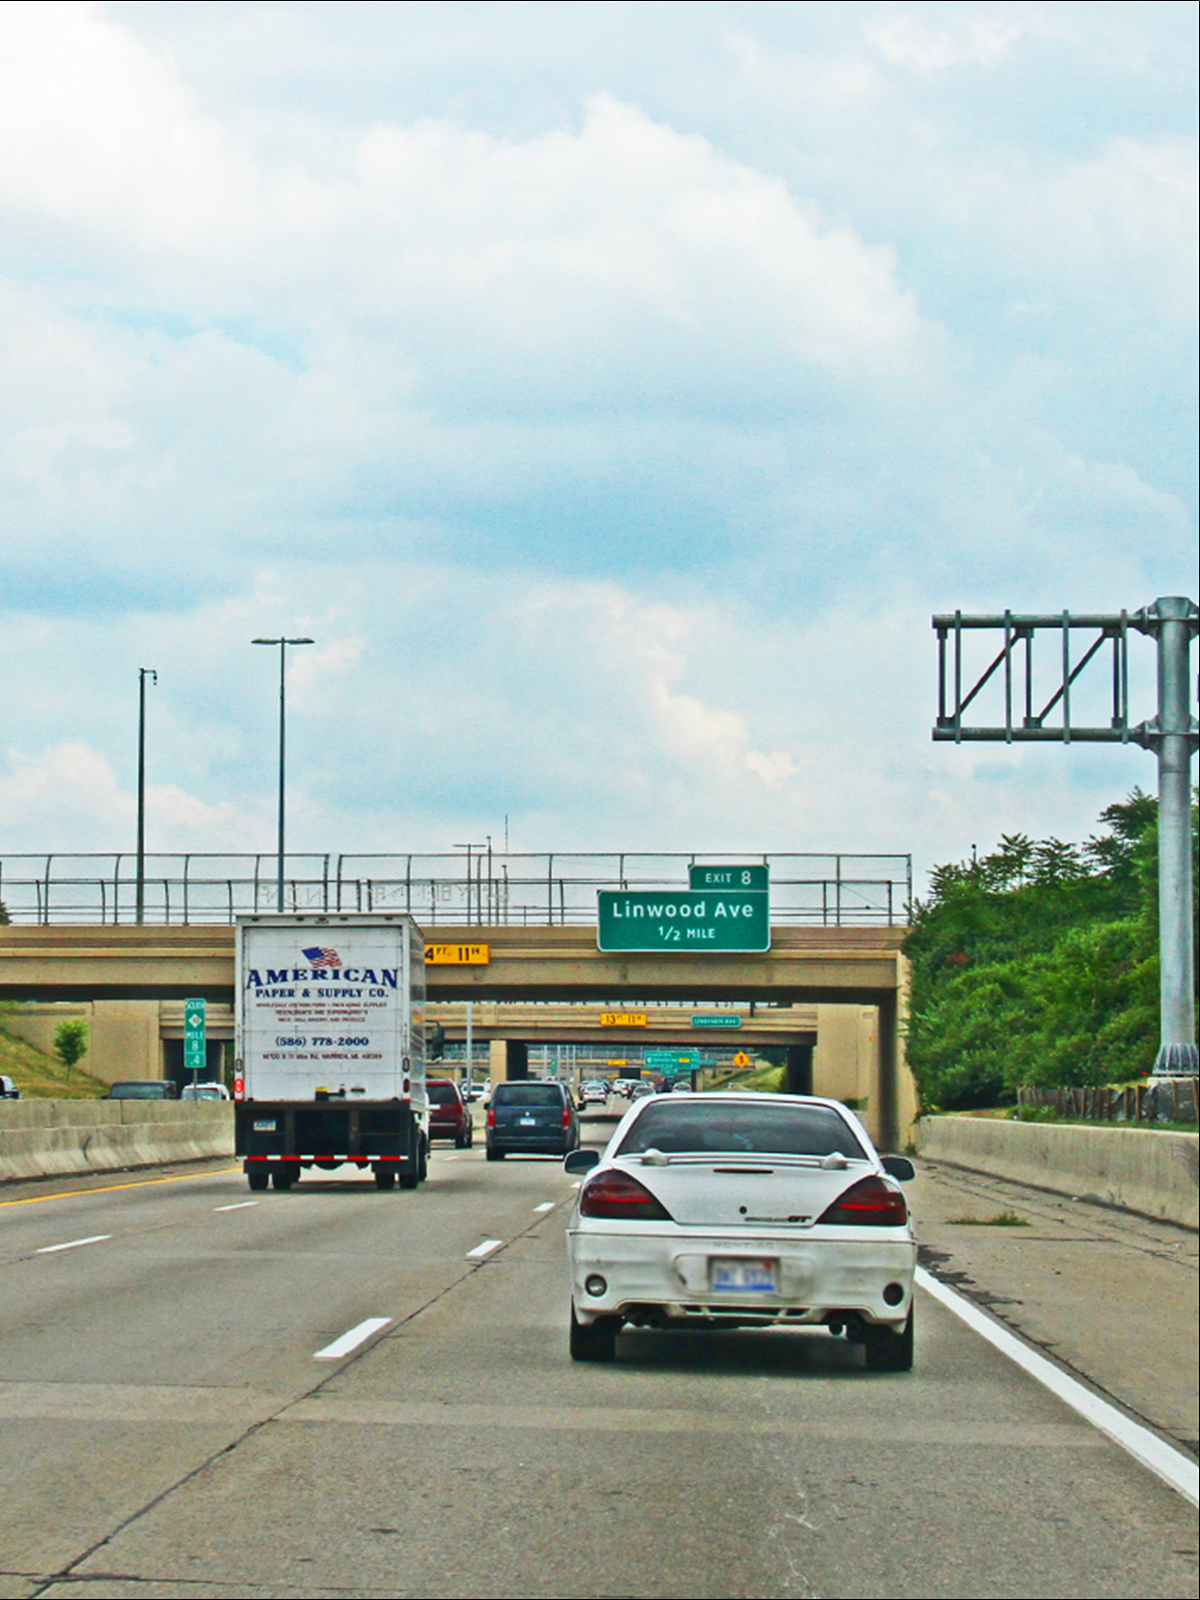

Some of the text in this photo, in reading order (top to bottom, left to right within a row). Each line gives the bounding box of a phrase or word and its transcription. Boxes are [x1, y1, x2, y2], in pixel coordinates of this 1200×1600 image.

[705, 870, 752, 885] EXIT 8
[613, 901, 754, 918] Linwood Ave
[686, 928, 716, 939] MILE
[246, 968, 399, 989] AMERICAN
[255, 988, 389, 998] PAPER & SUPPLY CO.
[275, 1036, 370, 1048] (586) 778-2000
[787, 1215, 812, 1223] GT
[713, 1241, 775, 1249] PONTIAC
